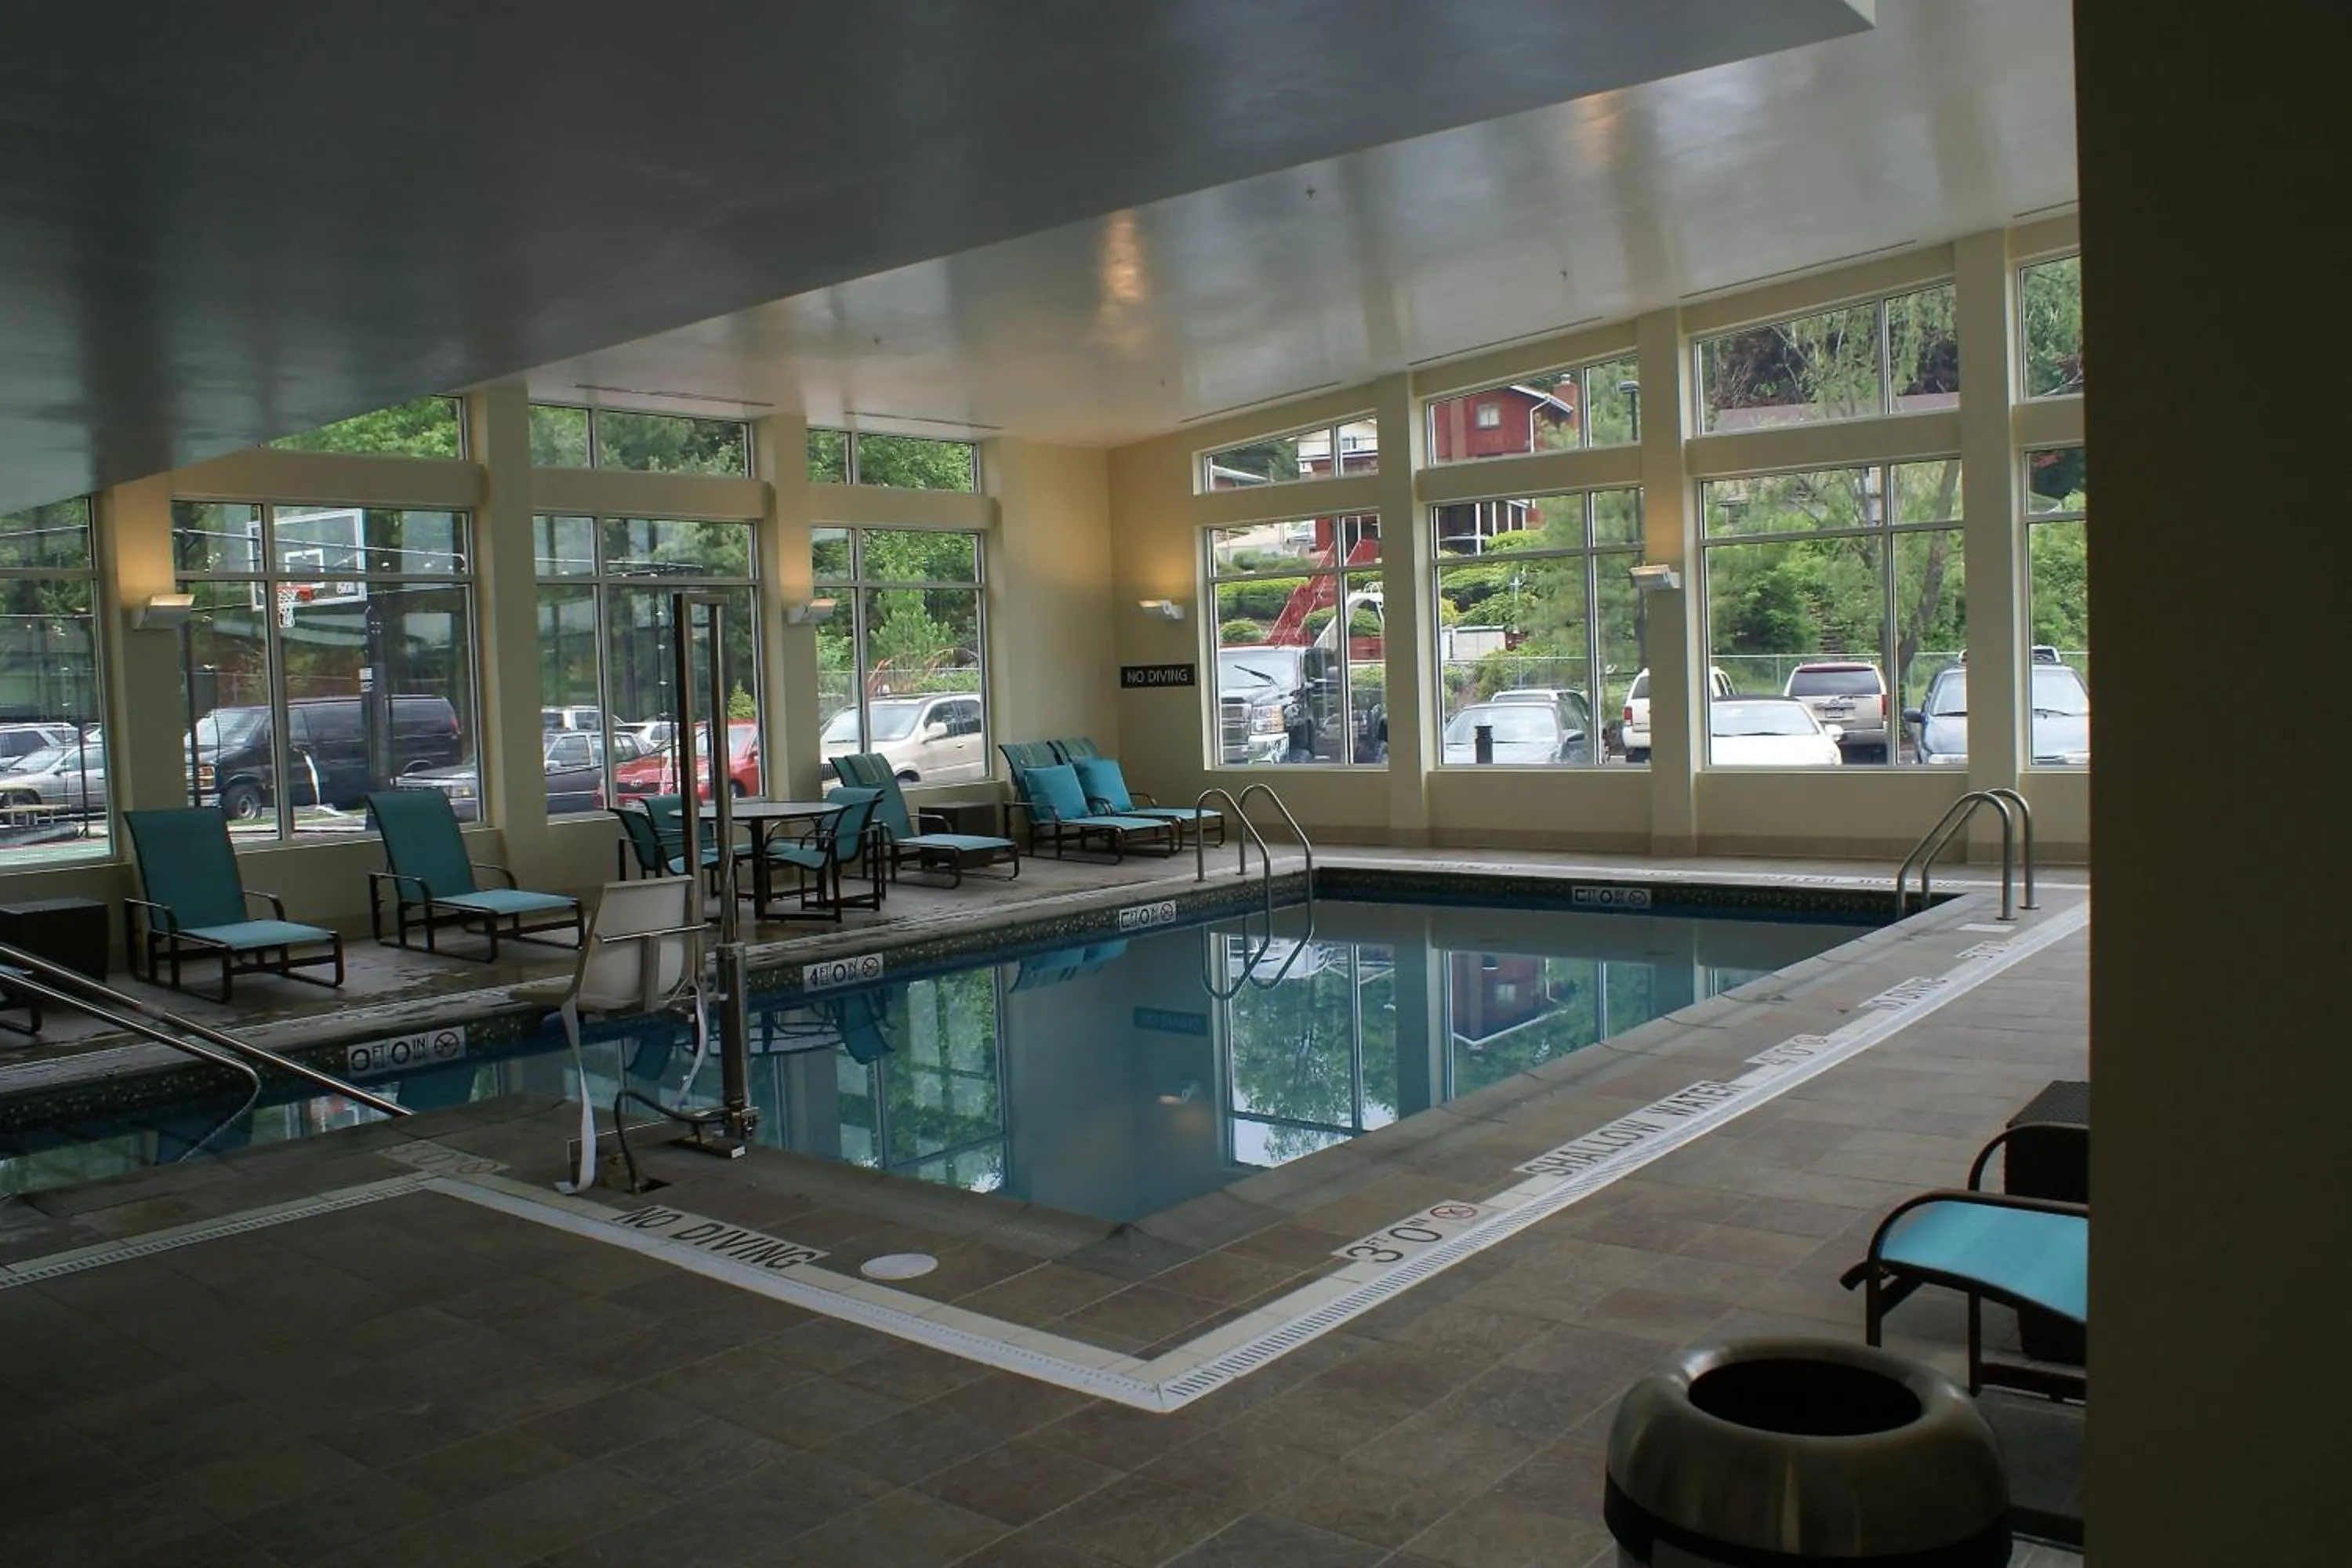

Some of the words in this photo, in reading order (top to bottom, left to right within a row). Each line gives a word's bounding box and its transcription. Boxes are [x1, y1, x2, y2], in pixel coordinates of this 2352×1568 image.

[1127, 670, 1145, 683] NO
[1148, 669, 1188, 683] DIVING
[1525, 1119, 1665, 1176] SHALLOW
[1645, 1081, 1748, 1117] WATER
[612, 1206, 684, 1229] NO
[669, 1223, 816, 1270] DIVING
